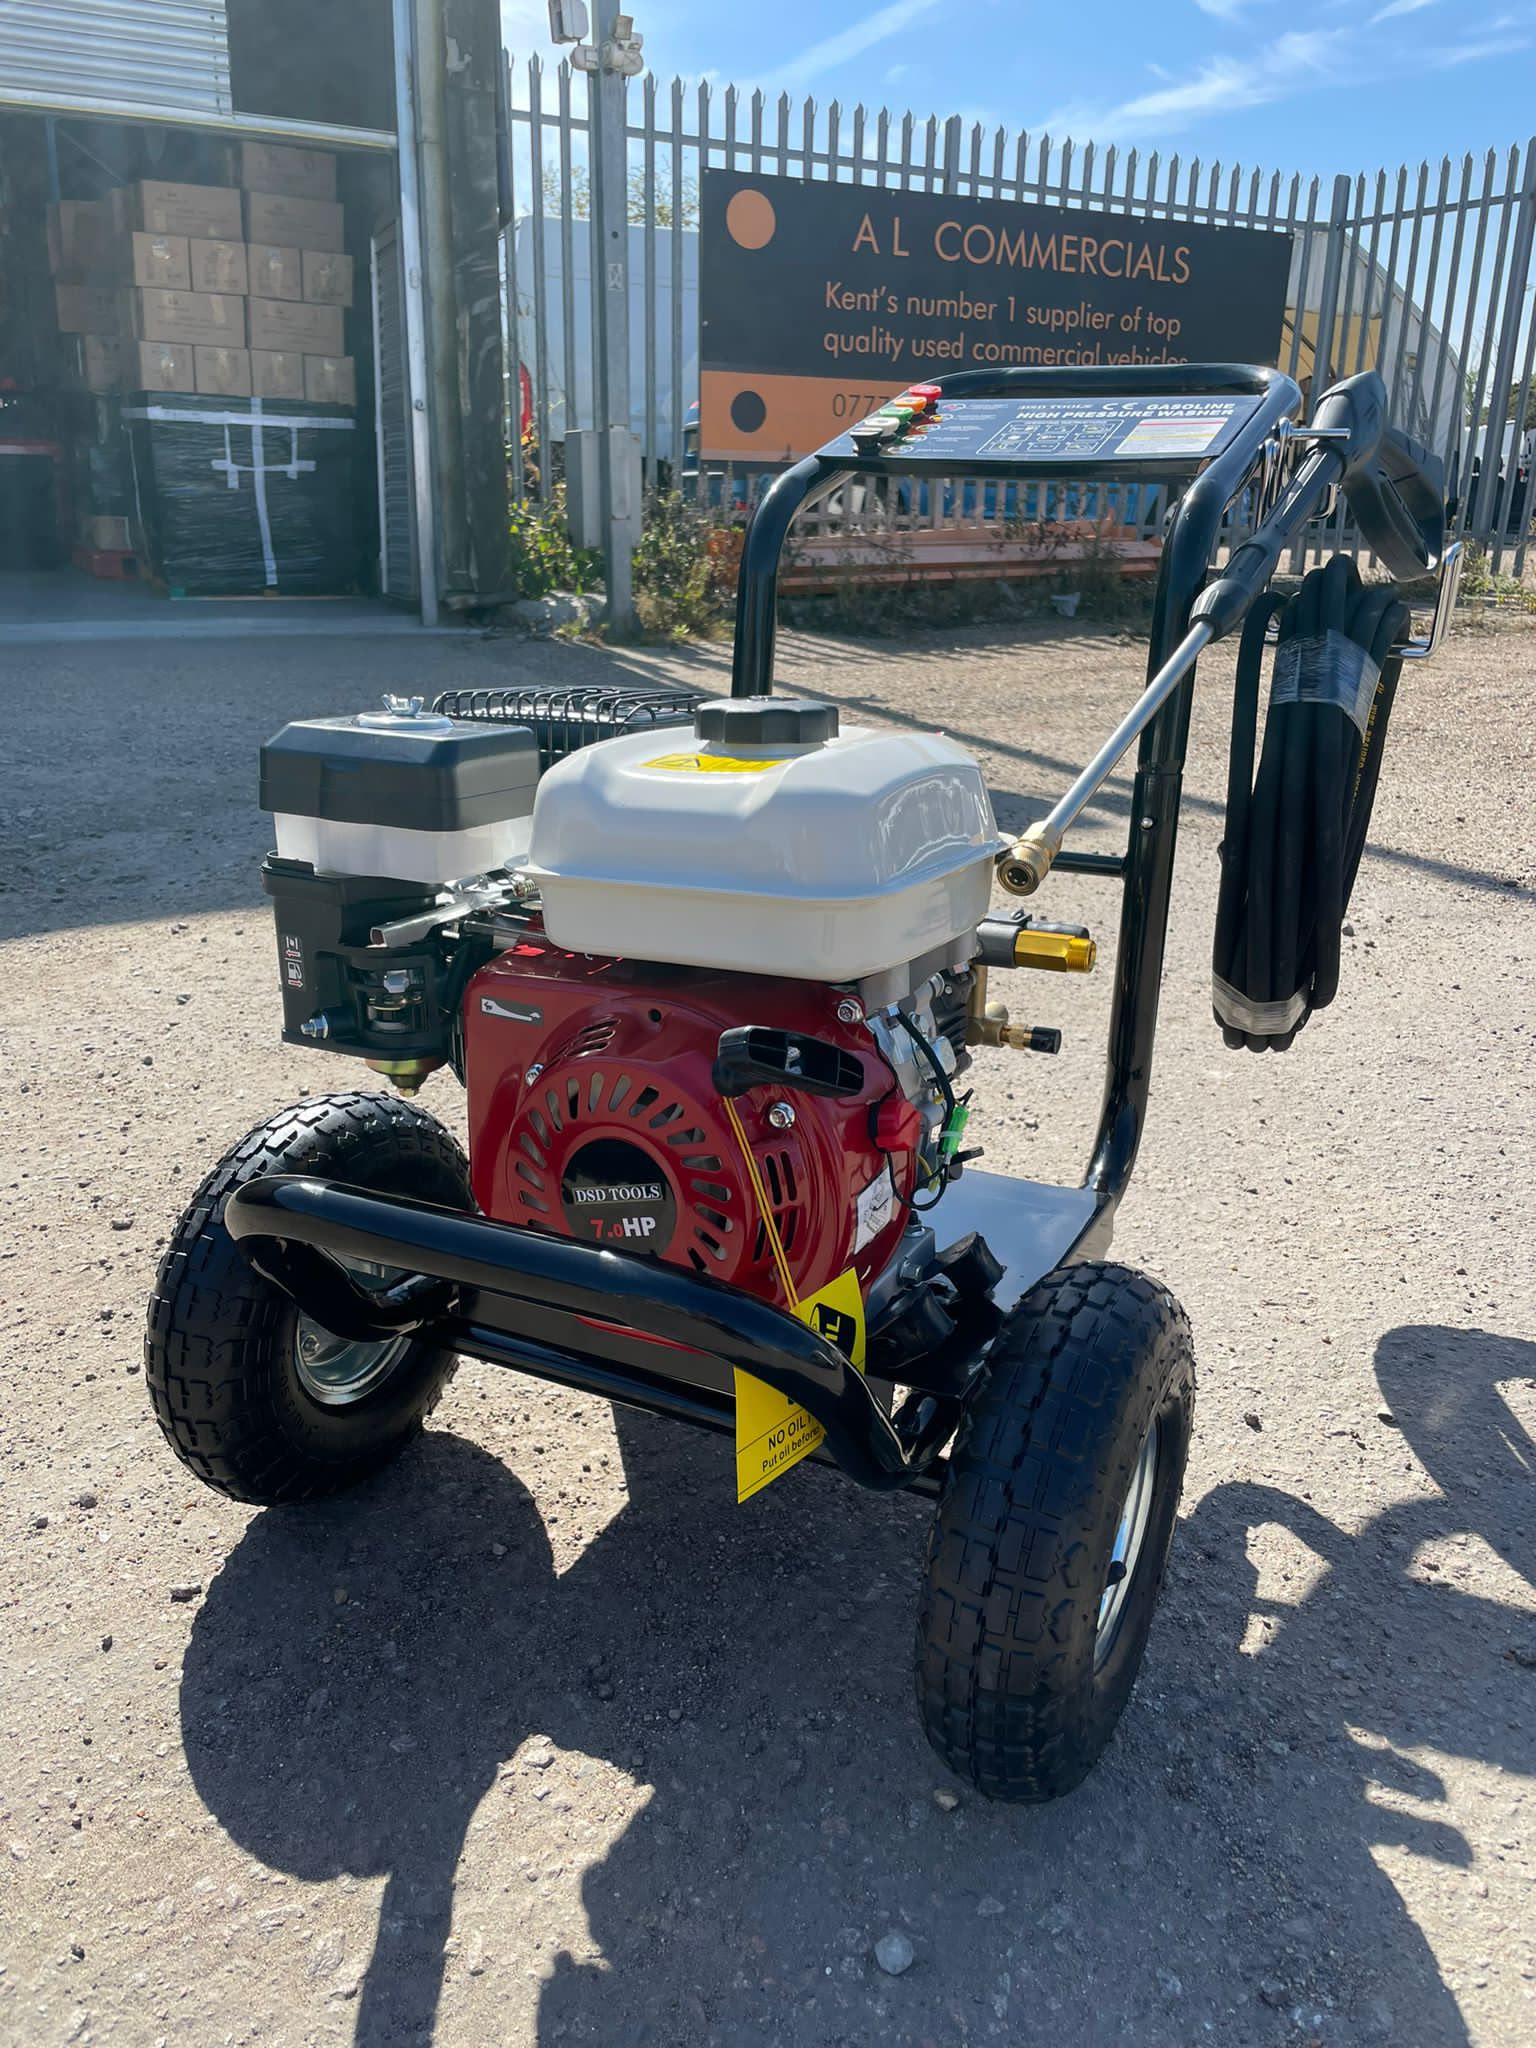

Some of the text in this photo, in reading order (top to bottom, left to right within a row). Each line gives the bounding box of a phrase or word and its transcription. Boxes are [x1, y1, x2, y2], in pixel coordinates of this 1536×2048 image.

[852, 212, 1191, 285] A L COMMERCIALS
[825, 281, 1182, 341] Kent's number 1 supplier of top
[823, 328, 904, 361] quality
[910, 336, 963, 360] used
[971, 342, 1101, 365] commercial
[832, 393, 890, 418] 077
[1062, 411, 1155, 419] PRESSURE
[1157, 409, 1234, 417] WASHER
[576, 1186, 660, 1202] DSD TOOLS
[590, 1217, 656, 1238] 7.0HP
[768, 1429, 785, 1450] NO
[788, 1416, 806, 1436] OIL
[762, 1453, 777, 1472] Put
[779, 1443, 790, 1460] oil
